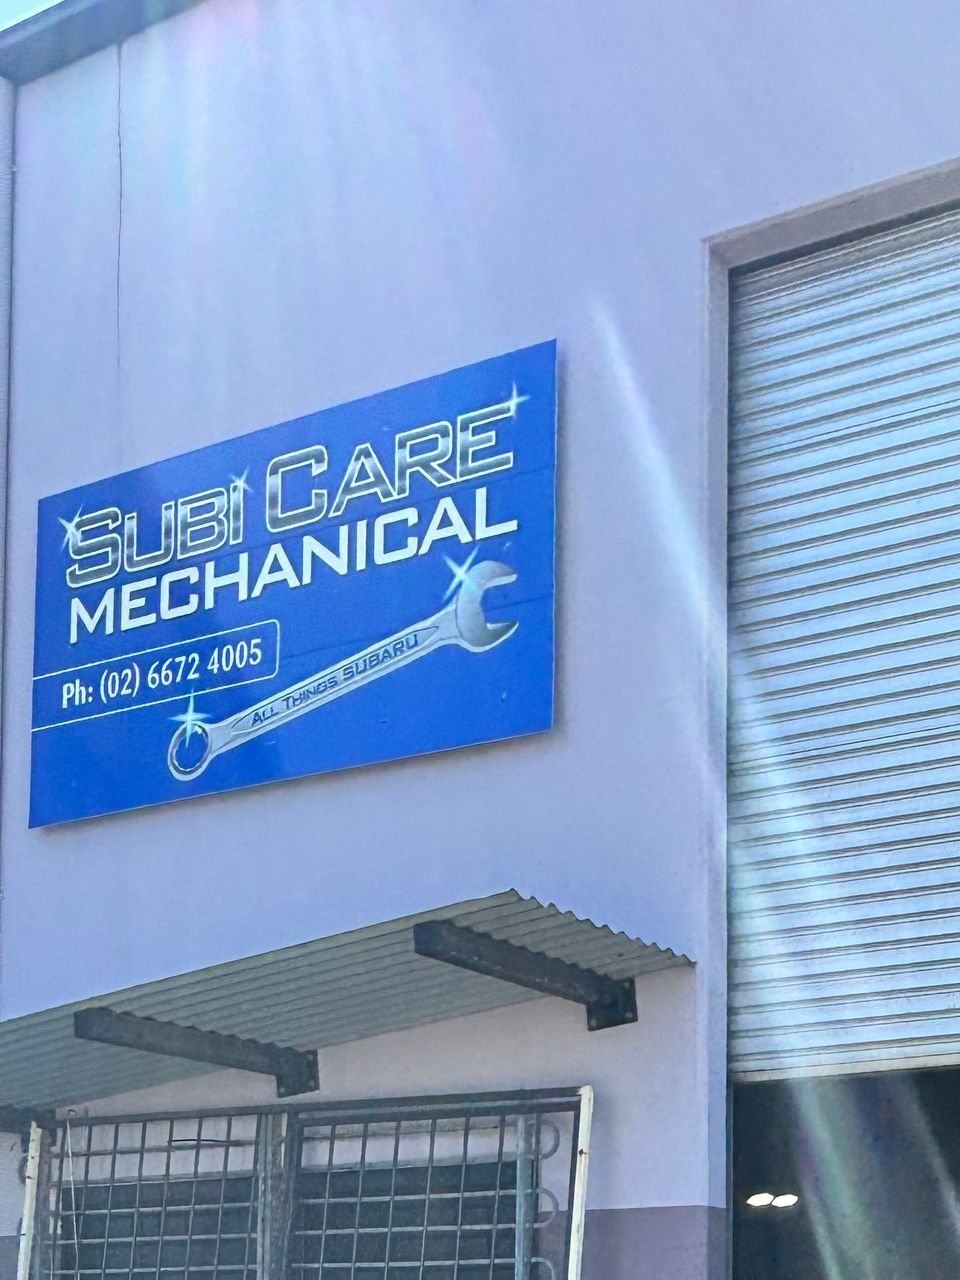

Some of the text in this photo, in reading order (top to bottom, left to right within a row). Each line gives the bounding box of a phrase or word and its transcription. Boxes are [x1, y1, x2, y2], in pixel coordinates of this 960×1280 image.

[66, 400, 514, 589] SUBI CARE
[69, 488, 518, 644] MECHANICAL
[62, 639, 262, 708] Ph: (02) 6672 4005
[251, 634, 418, 727] ALL THINGS SUBARU
